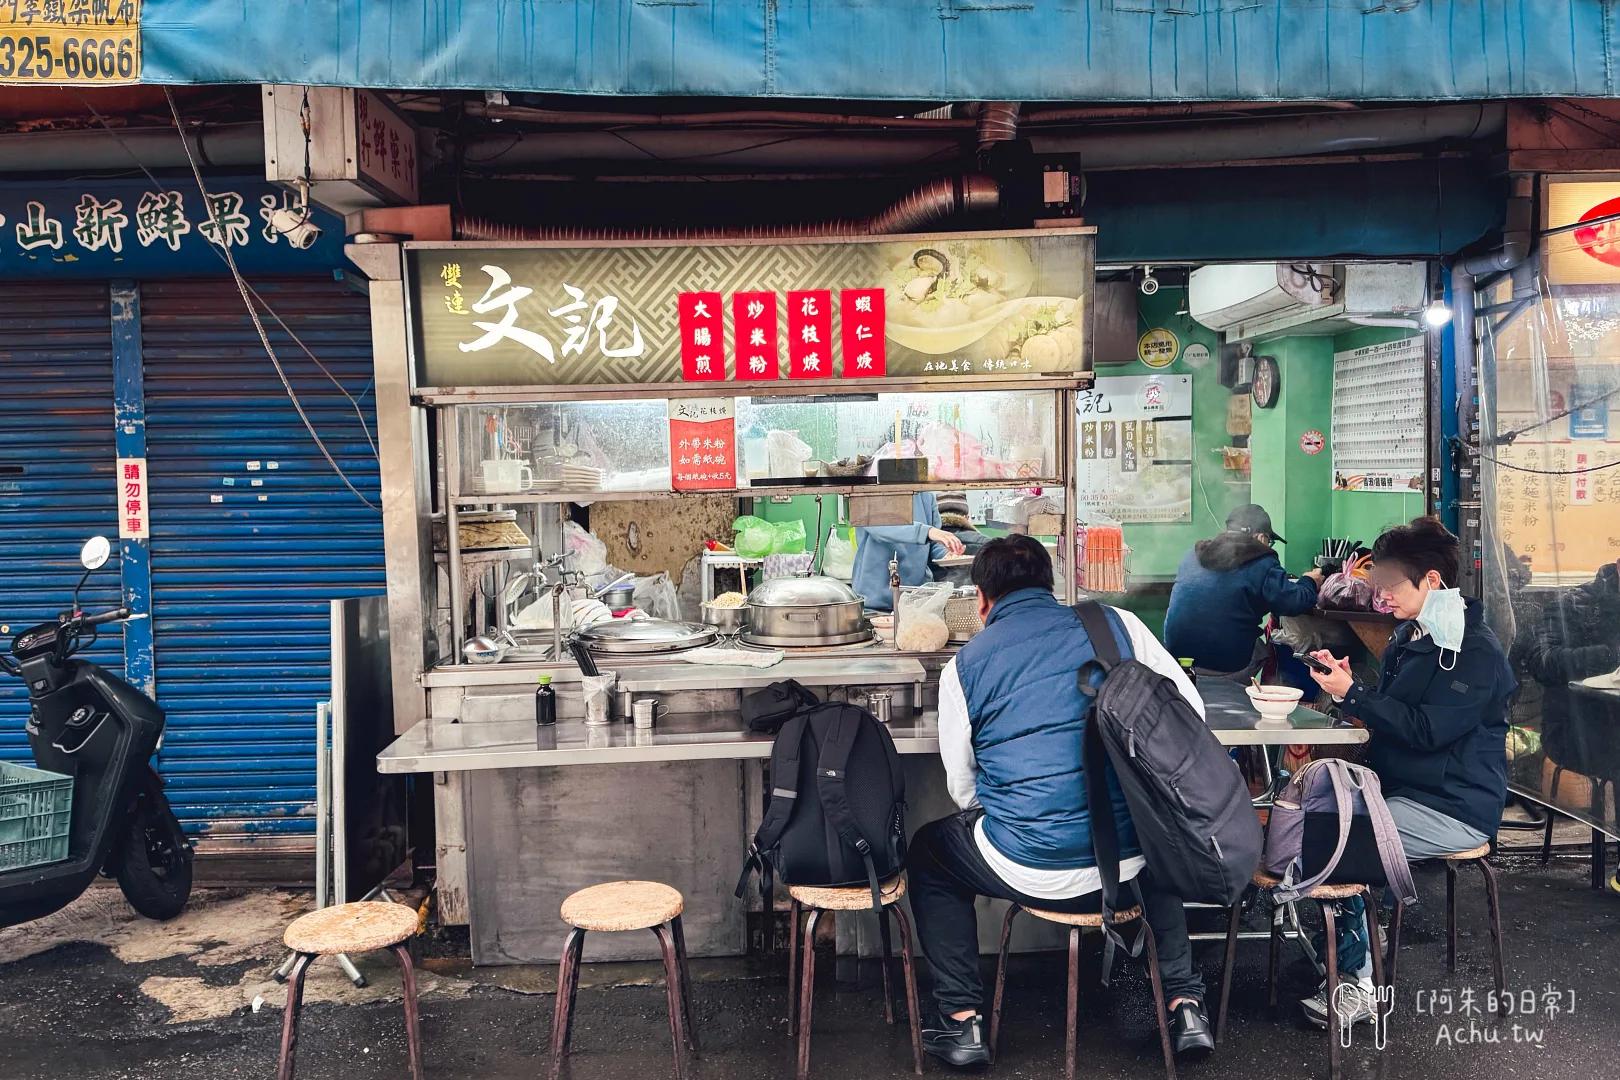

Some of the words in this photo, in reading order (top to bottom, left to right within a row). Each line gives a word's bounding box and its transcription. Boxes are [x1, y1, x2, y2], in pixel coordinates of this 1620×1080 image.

[0, 36, 133, 78] 325-6666
[440, 262, 469, 315] 雙連
[458, 264, 644, 364] 文記
[693, 300, 713, 375] 大腸煎
[747, 300, 768, 374] 炒米粉
[801, 297, 821, 372] 花枝焿
[855, 295, 874, 370] 蝦仁焿
[923, 359, 971, 373] 在地美食
[982, 357, 1032, 371] 傳統口味
[1076, 389, 1112, 416] 記
[678, 438, 726, 451] 外帶米粉
[678, 454, 727, 466] 如需紙碗
[1084, 423, 1095, 458] 炒米粉
[124, 464, 142, 534] 請勿停車
[1524, 544, 1536, 553] 65
